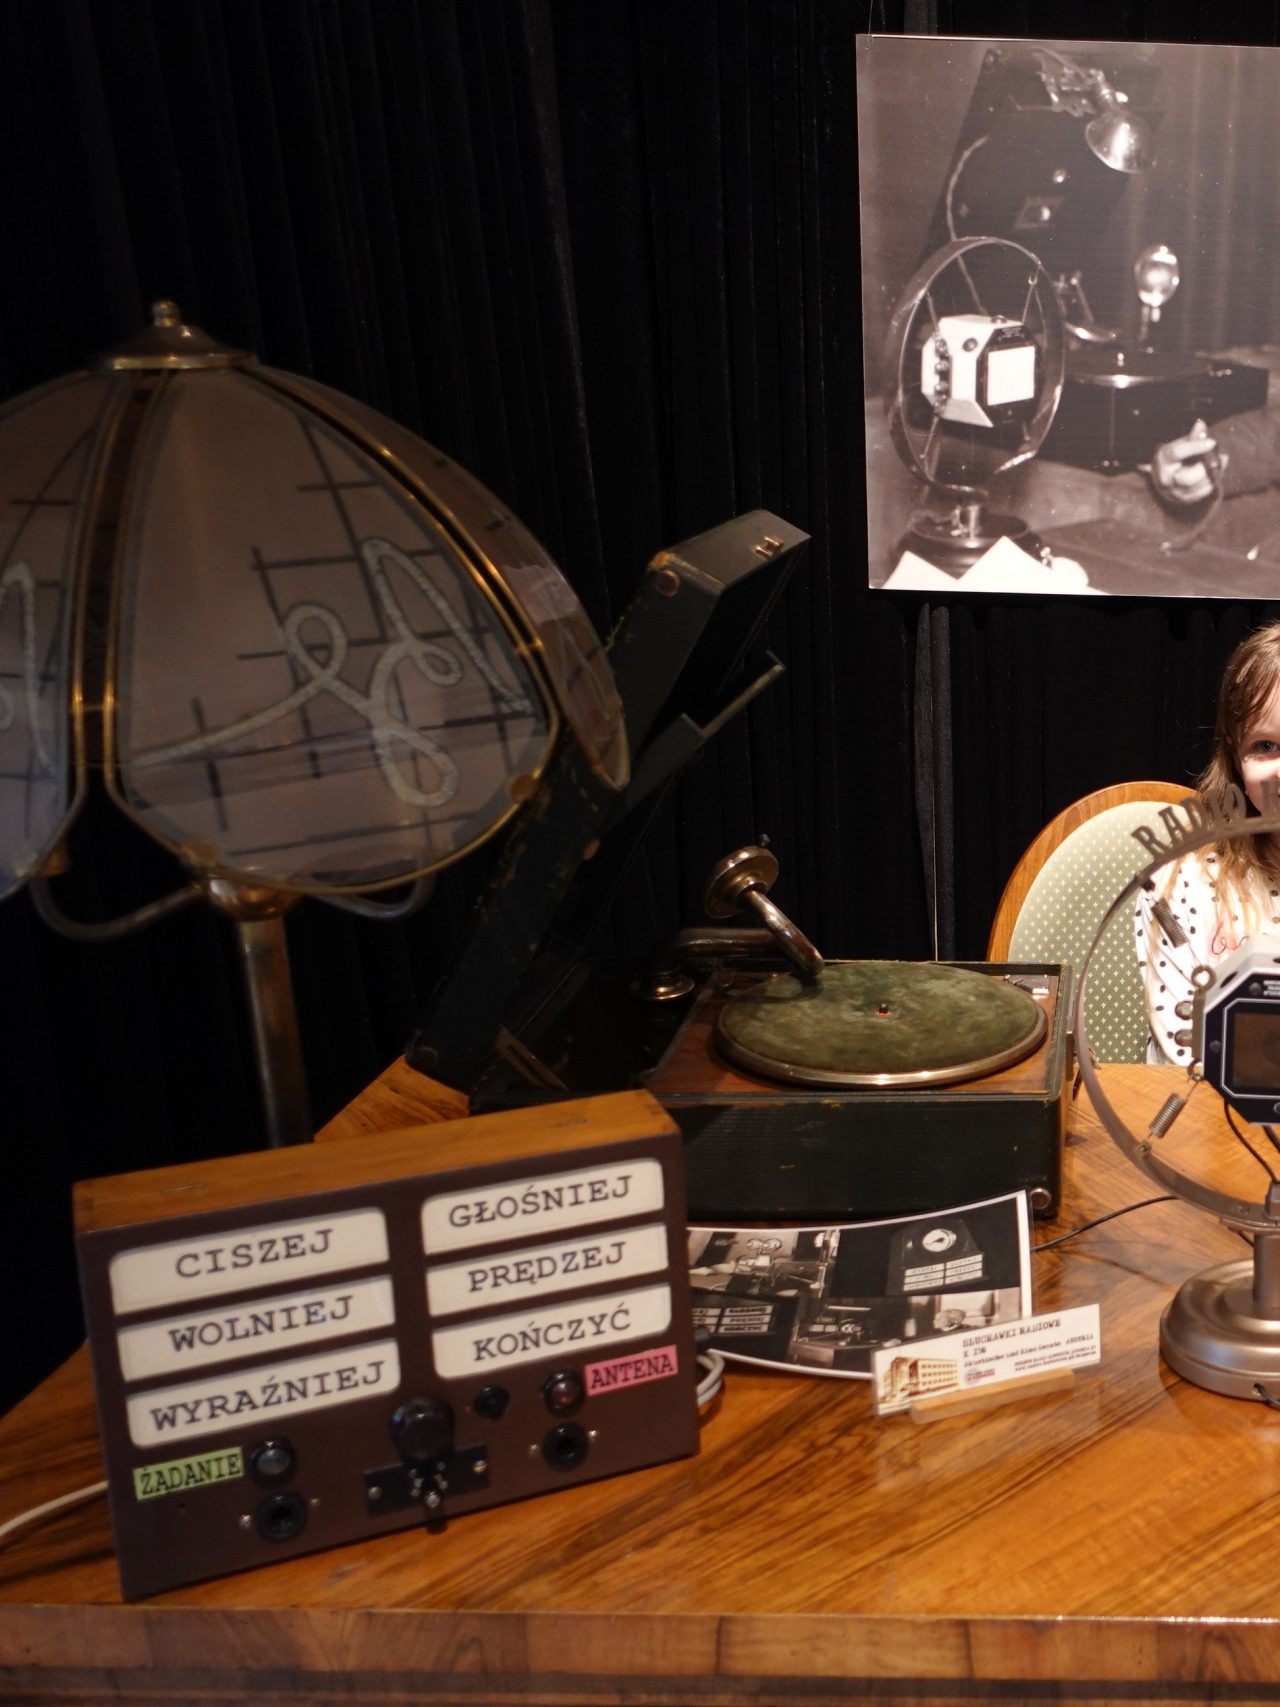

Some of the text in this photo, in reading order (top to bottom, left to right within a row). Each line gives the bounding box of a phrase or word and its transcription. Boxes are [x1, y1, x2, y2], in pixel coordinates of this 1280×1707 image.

[1131, 784, 1246, 861] RADIO
[448, 1175, 634, 1229] GŁOŚNIEJ
[176, 1229, 333, 1278] CISZEJ
[467, 1241, 627, 1293] PRĘDZEJ
[168, 1295, 354, 1352] WOLNIEJ
[473, 1305, 631, 1361] KOŃCZYĆ
[150, 1361, 386, 1430] WYRAŹNIEJ
[590, 1354, 675, 1389] ANTENA
